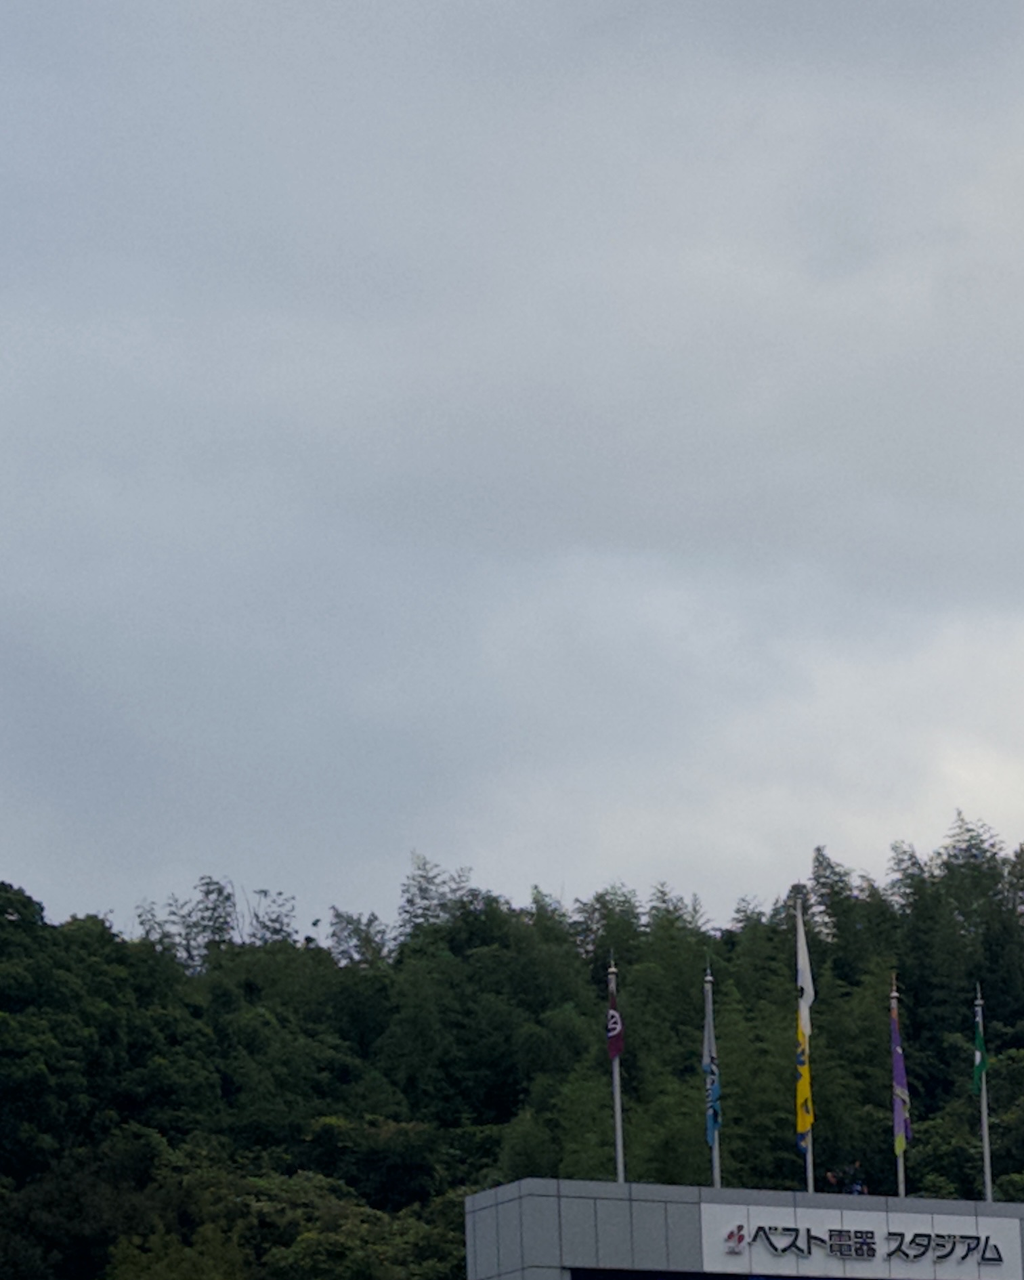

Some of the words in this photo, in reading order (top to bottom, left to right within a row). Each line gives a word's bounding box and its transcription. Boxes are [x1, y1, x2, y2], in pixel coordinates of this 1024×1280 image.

[749, 1225, 877, 1257] ベスト電器
[886, 1231, 1004, 1263] スタジアム
